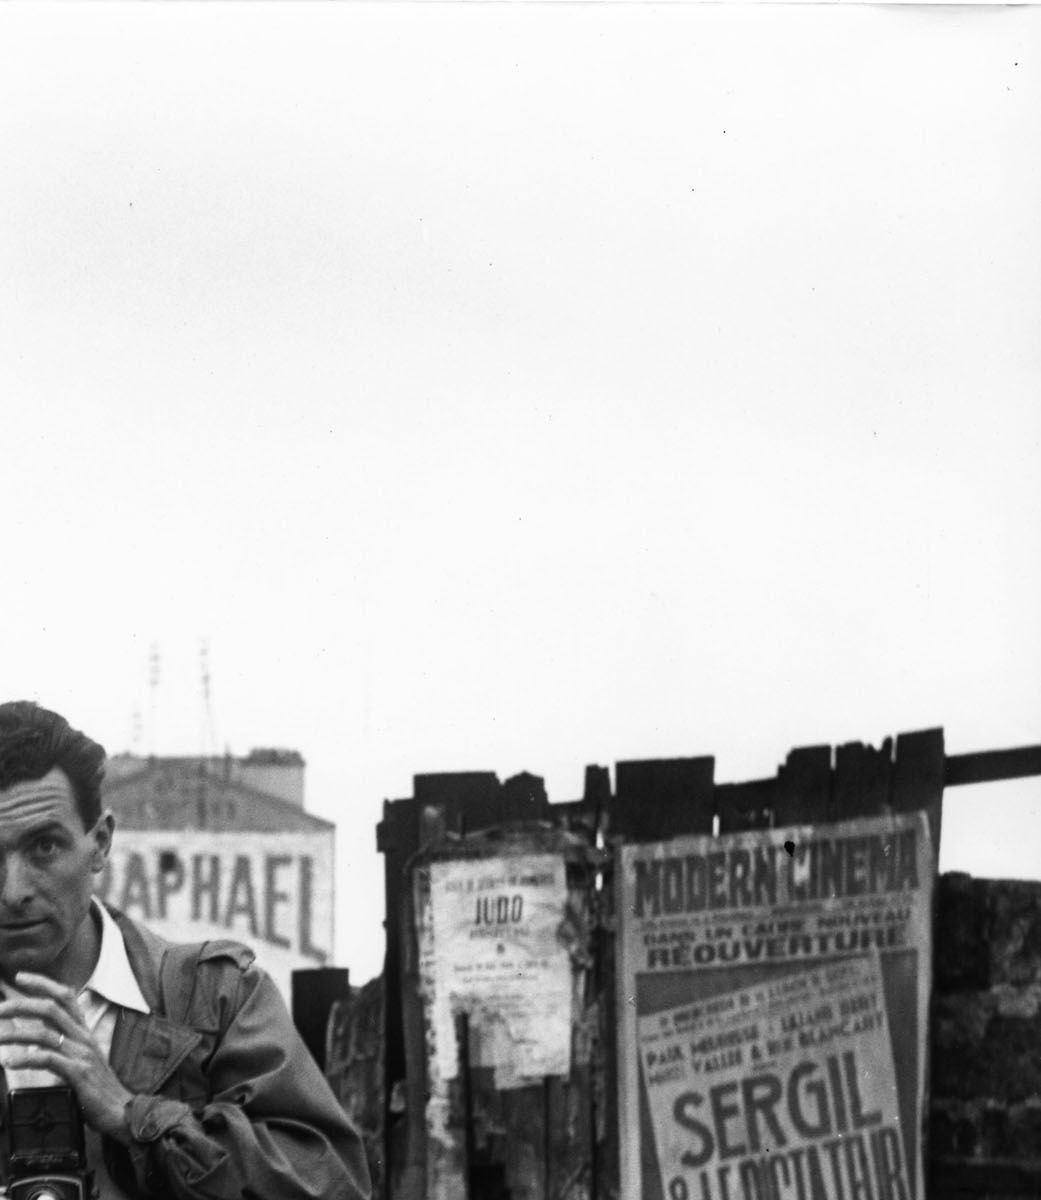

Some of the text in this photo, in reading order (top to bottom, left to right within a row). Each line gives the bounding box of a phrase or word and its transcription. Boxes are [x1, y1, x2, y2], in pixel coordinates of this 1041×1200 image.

[474, 894, 524, 926] JUDO
[634, 846, 776, 917] MODERN
[673, 1051, 883, 1168] SERGIL
